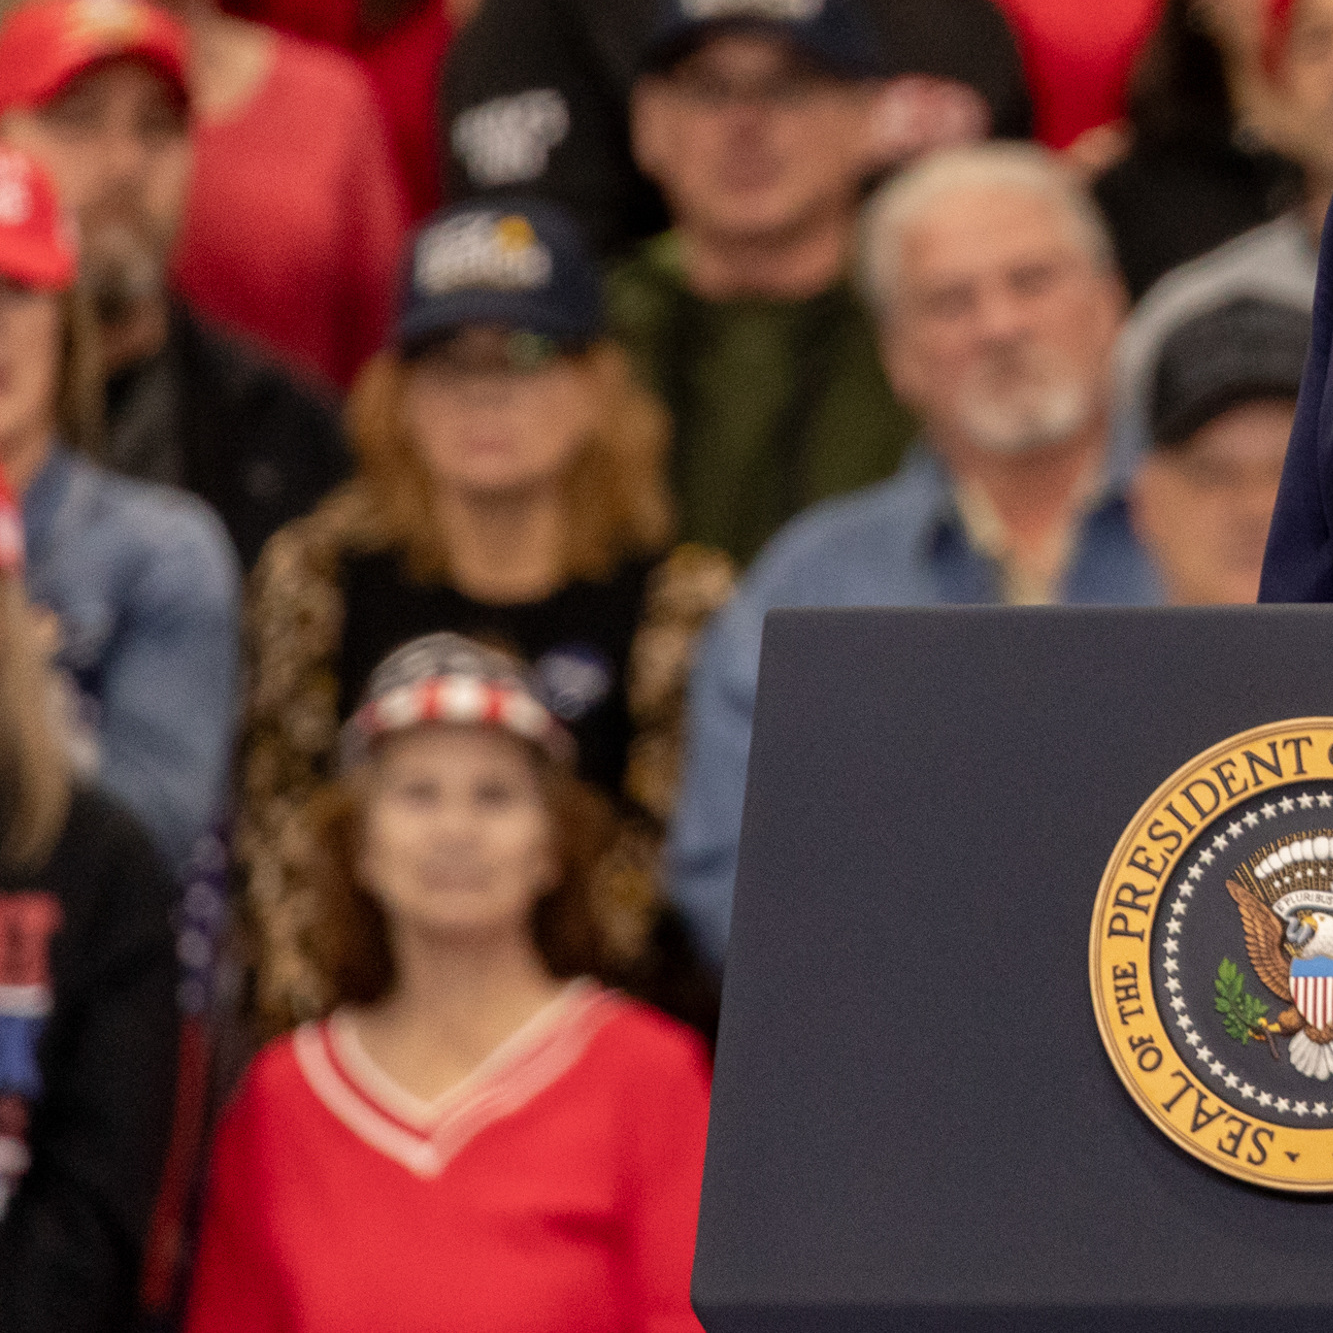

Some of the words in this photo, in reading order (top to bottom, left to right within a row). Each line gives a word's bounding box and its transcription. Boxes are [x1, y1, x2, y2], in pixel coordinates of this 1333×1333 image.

[1107, 736, 1313, 942] PRESIDENT
[1284, 892, 1333, 906] PLURIBUS
[1112, 961, 1144, 1026] THE
[1128, 1034, 1164, 1072] OF
[1162, 1068, 1276, 1166] SEAL
